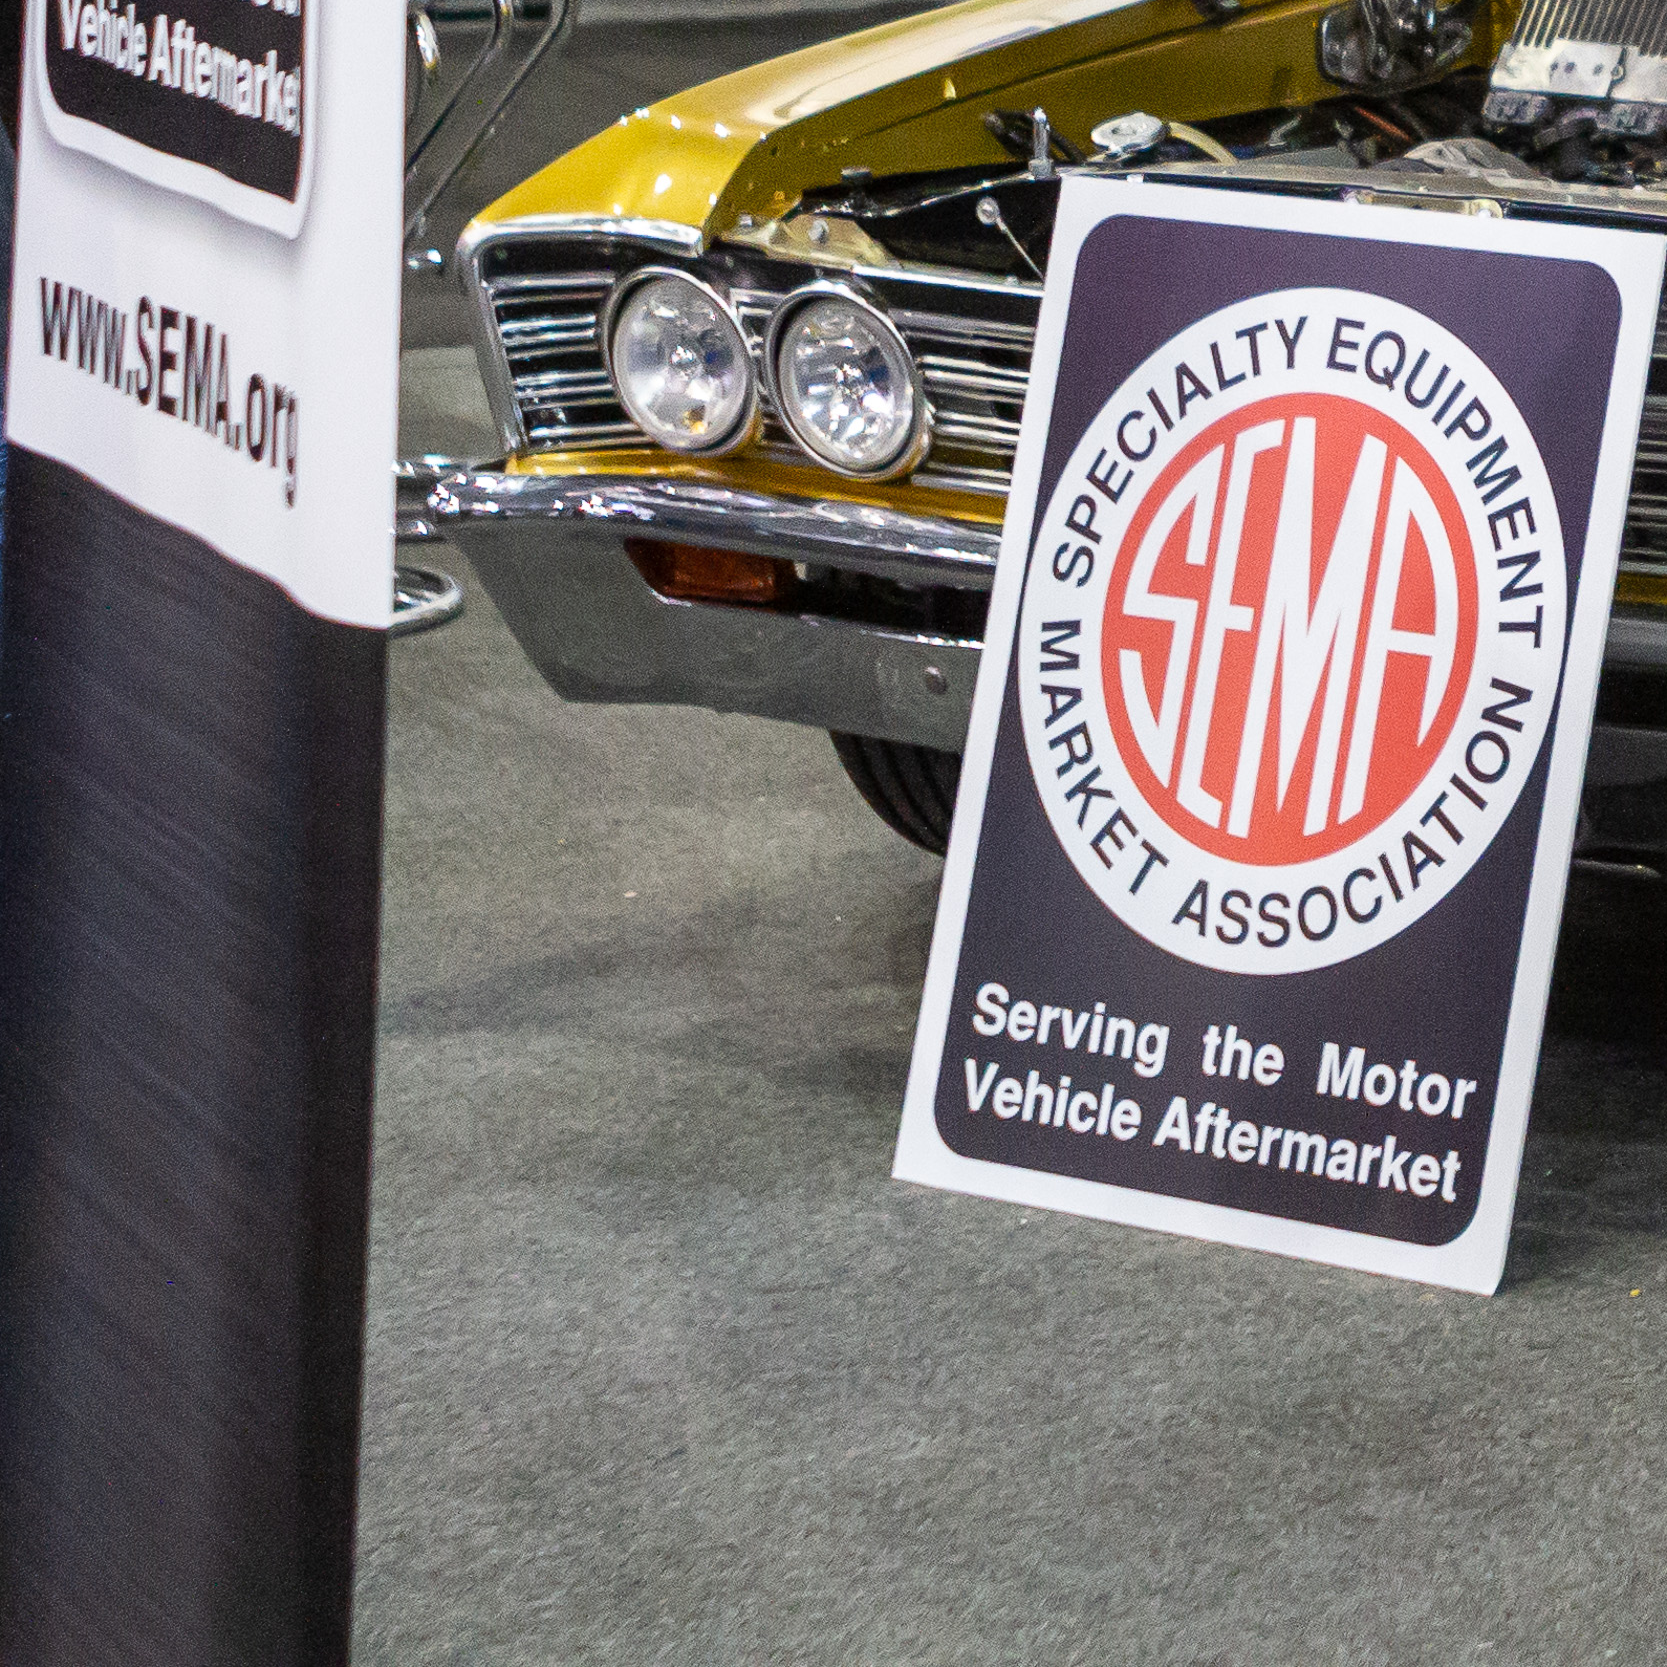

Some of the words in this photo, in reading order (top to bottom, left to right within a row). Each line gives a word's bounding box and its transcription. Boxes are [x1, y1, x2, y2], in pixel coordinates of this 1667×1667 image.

[1053, 316, 1308, 587] SPECIALTY
[1326, 317, 1544, 648] EQUIPMENT
[1119, 416, 1459, 839] SEMA
[1040, 619, 1169, 896] MARKET
[1172, 677, 1534, 947] ASSOCIATION
[964, 1057, 1141, 1140] Vehicle
[1152, 1095, 1462, 1202] Aftermarket
[972, 983, 1169, 1078] Serving
[1202, 1024, 1286, 1086] the
[1316, 1042, 1477, 1119] Motor
